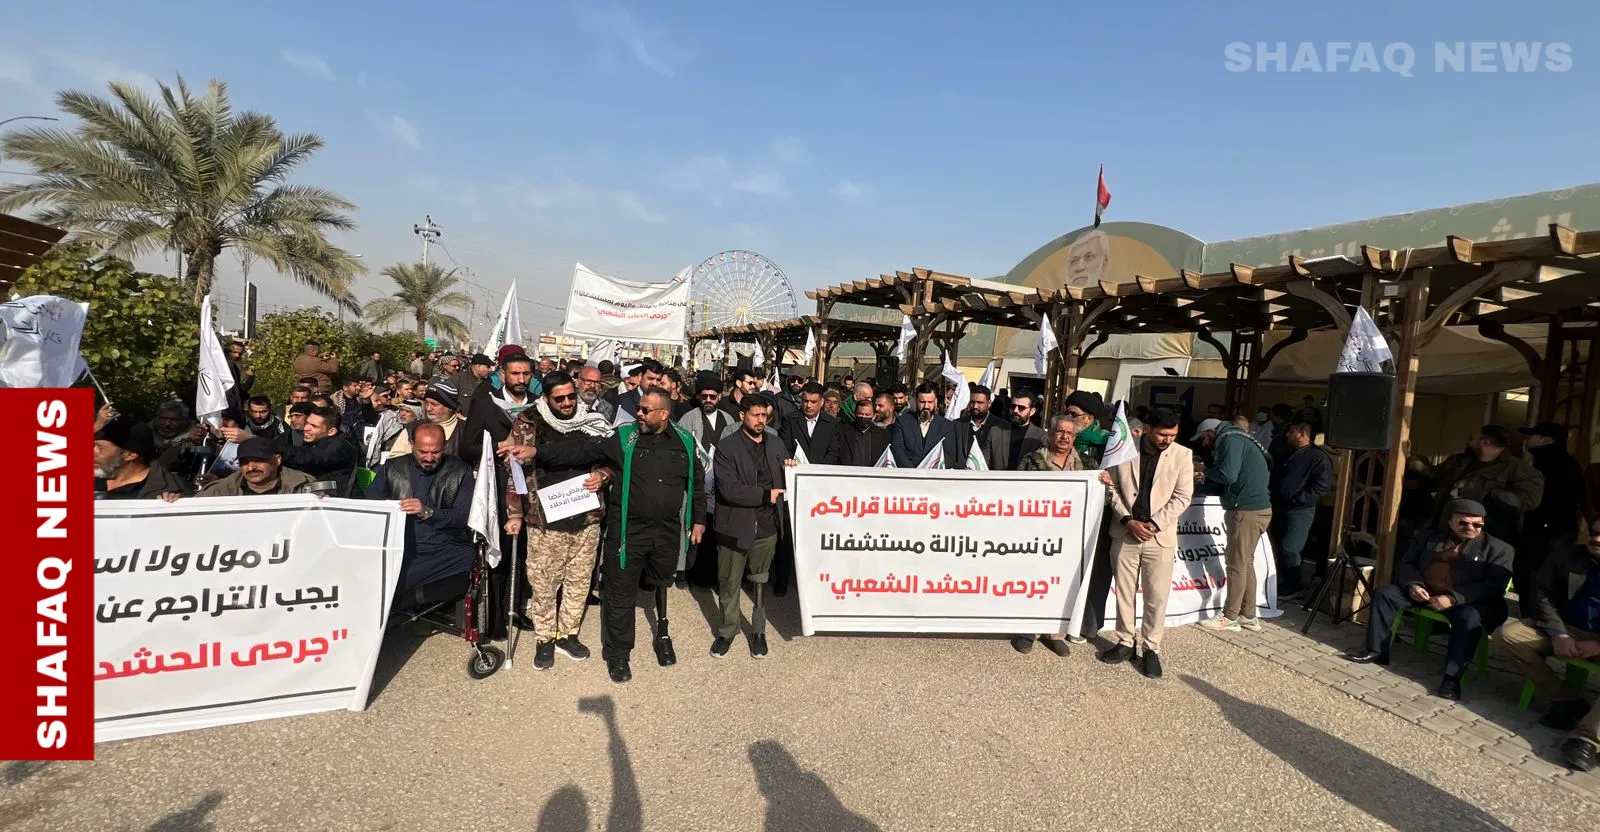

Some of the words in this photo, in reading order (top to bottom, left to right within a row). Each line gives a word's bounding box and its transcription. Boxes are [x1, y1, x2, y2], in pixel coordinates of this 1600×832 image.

[810, 496, 880, 517] قراركم
[884, 497, 940, 519] وقتلنا
[945, 497, 1014, 518] داعش..
[1019, 498, 1071, 518] قاتلنا
[268, 539, 291, 564] لا
[821, 533, 925, 554] مستشفانا
[930, 534, 978, 557] بازالة
[982, 536, 1038, 557] نسمح
[1043, 537, 1063, 556] لن
[94, 549, 140, 574] اس
[145, 545, 191, 576] ولا
[196, 544, 261, 572] مول
[820, 573, 918, 599] الشعبي"
[922, 573, 988, 594] الحشد
[993, 576, 1060, 599] "جرحى
[1172, 573, 1216, 591] الحشد
[96, 594, 144, 623] عن
[147, 585, 268, 622] التراجع
[275, 584, 339, 612] يجب
[231, 628, 348, 667] "جرحى
[94, 642, 221, 680] الحشد
